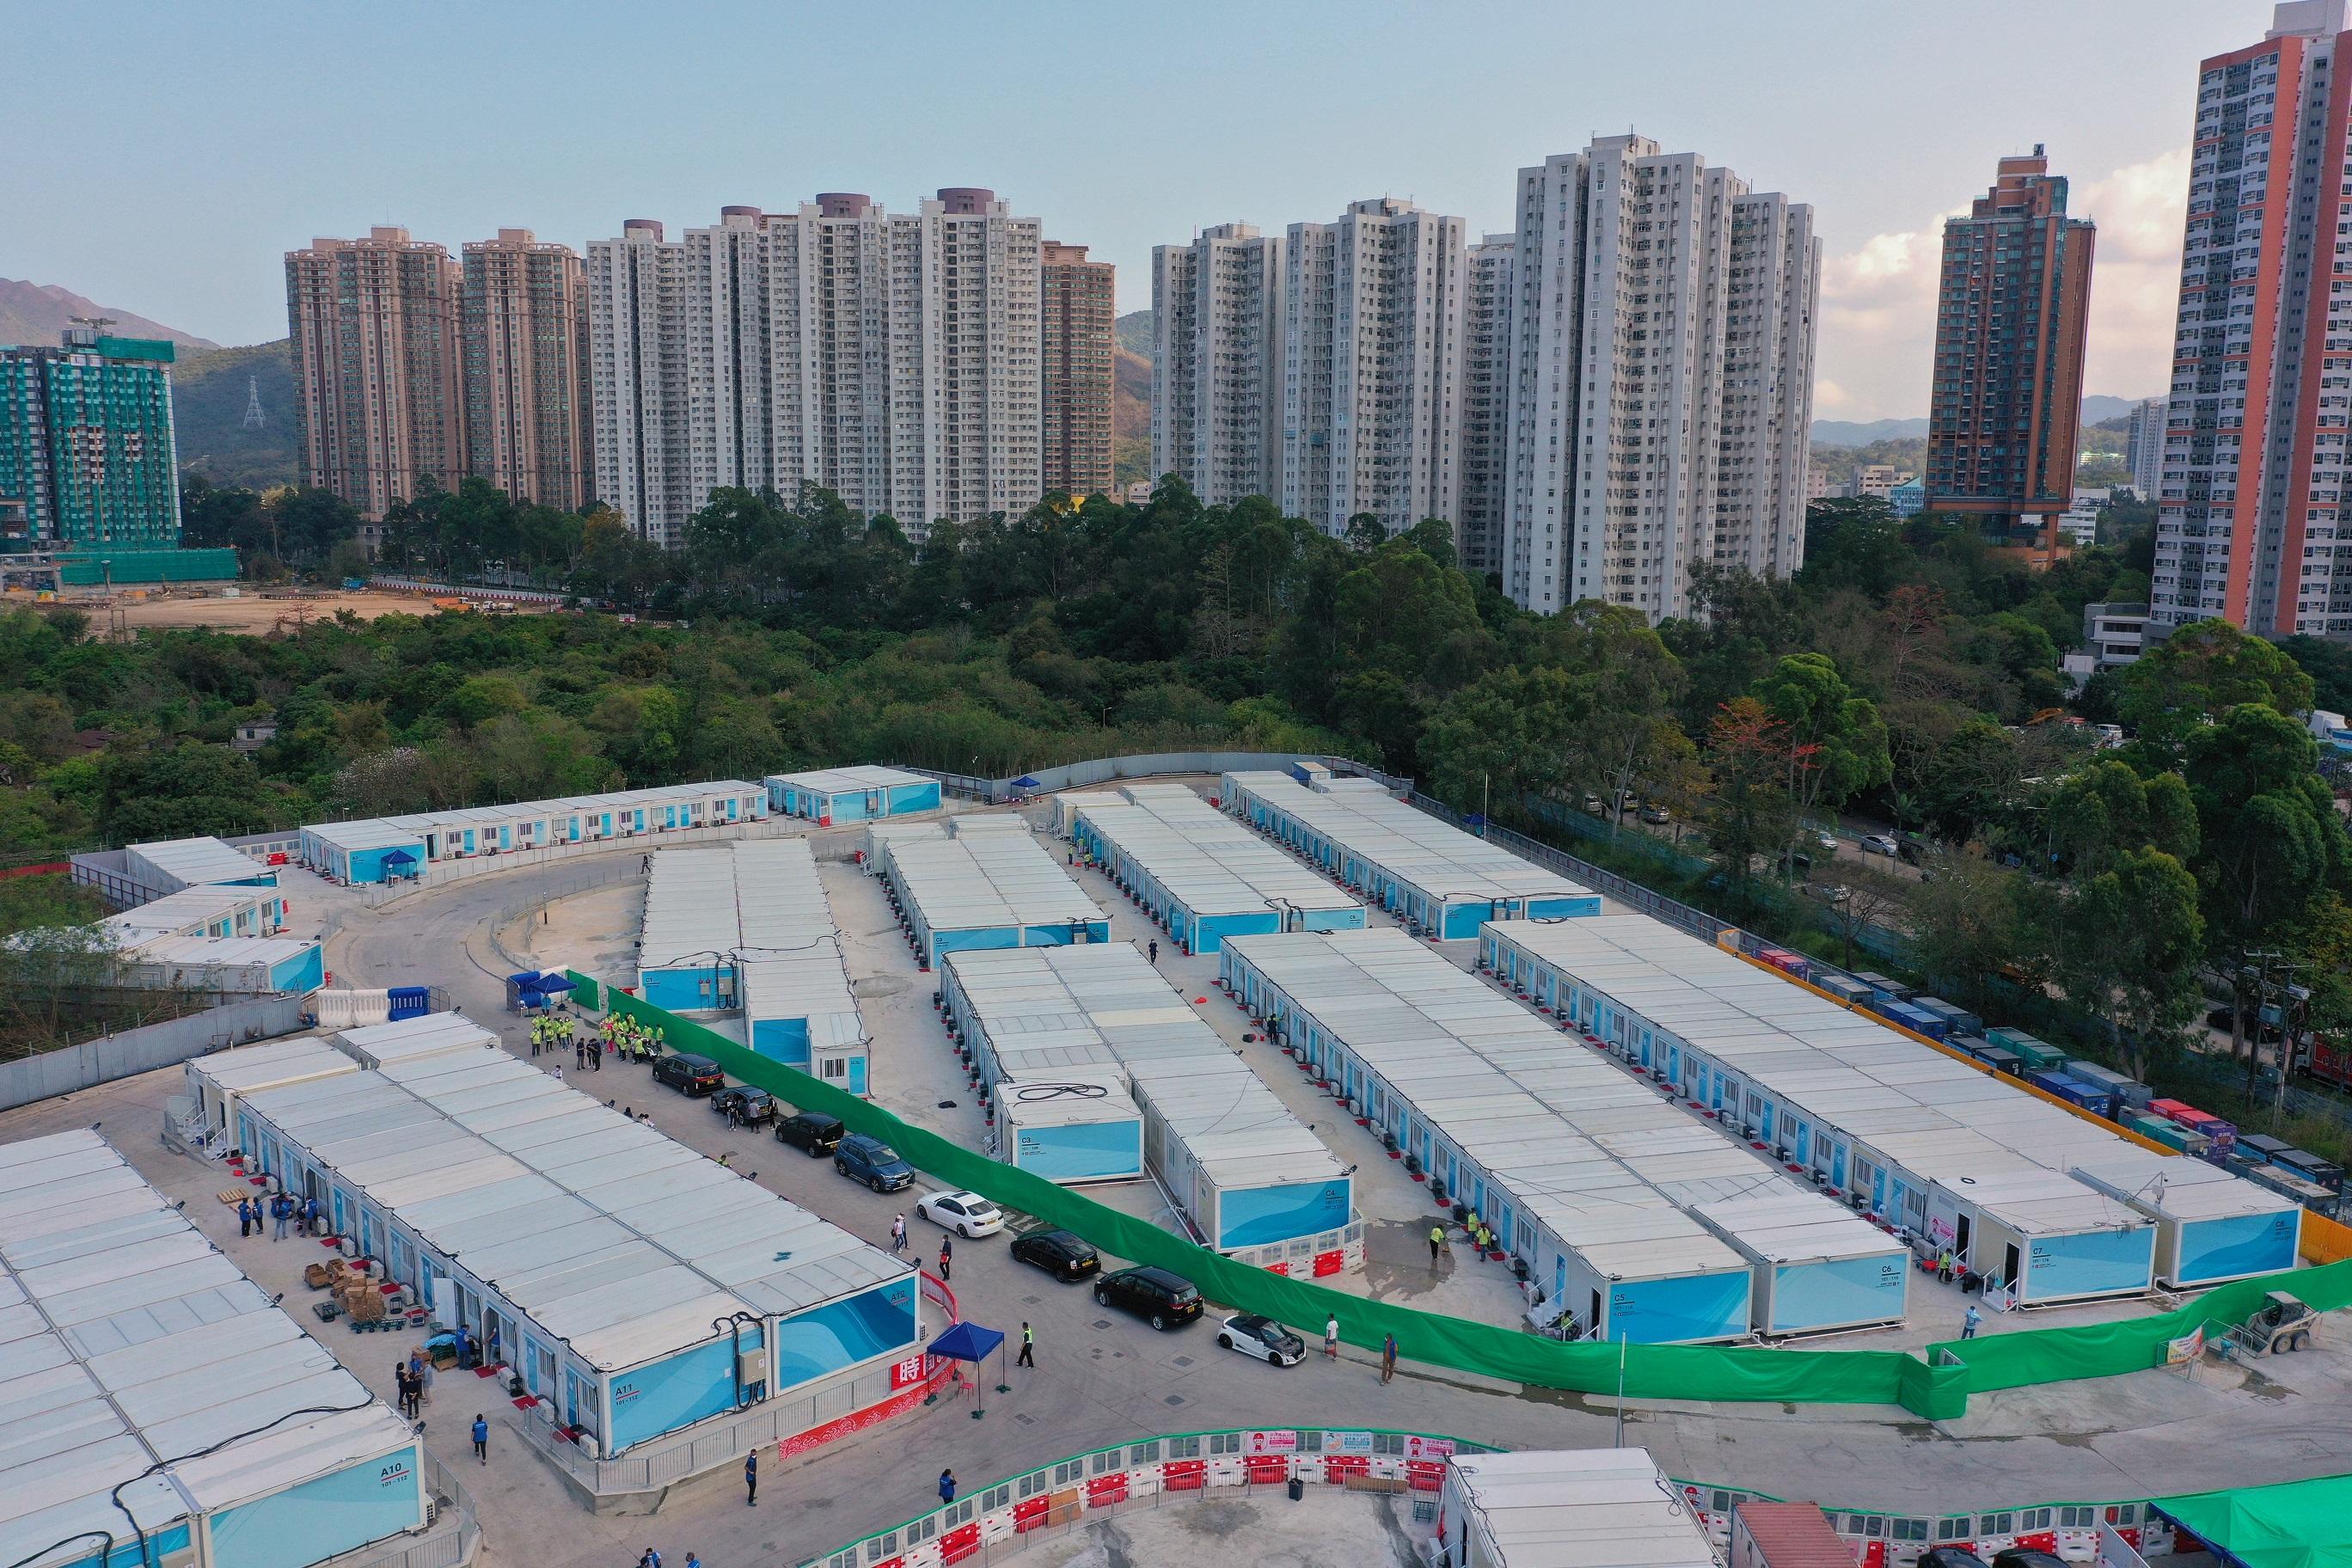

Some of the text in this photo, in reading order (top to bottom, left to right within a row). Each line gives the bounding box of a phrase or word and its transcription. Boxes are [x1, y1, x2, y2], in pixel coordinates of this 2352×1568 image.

[891, 1290, 905, 1302] A12
[616, 1383, 632, 1396] A11
[381, 1462, 401, 1477] A10
